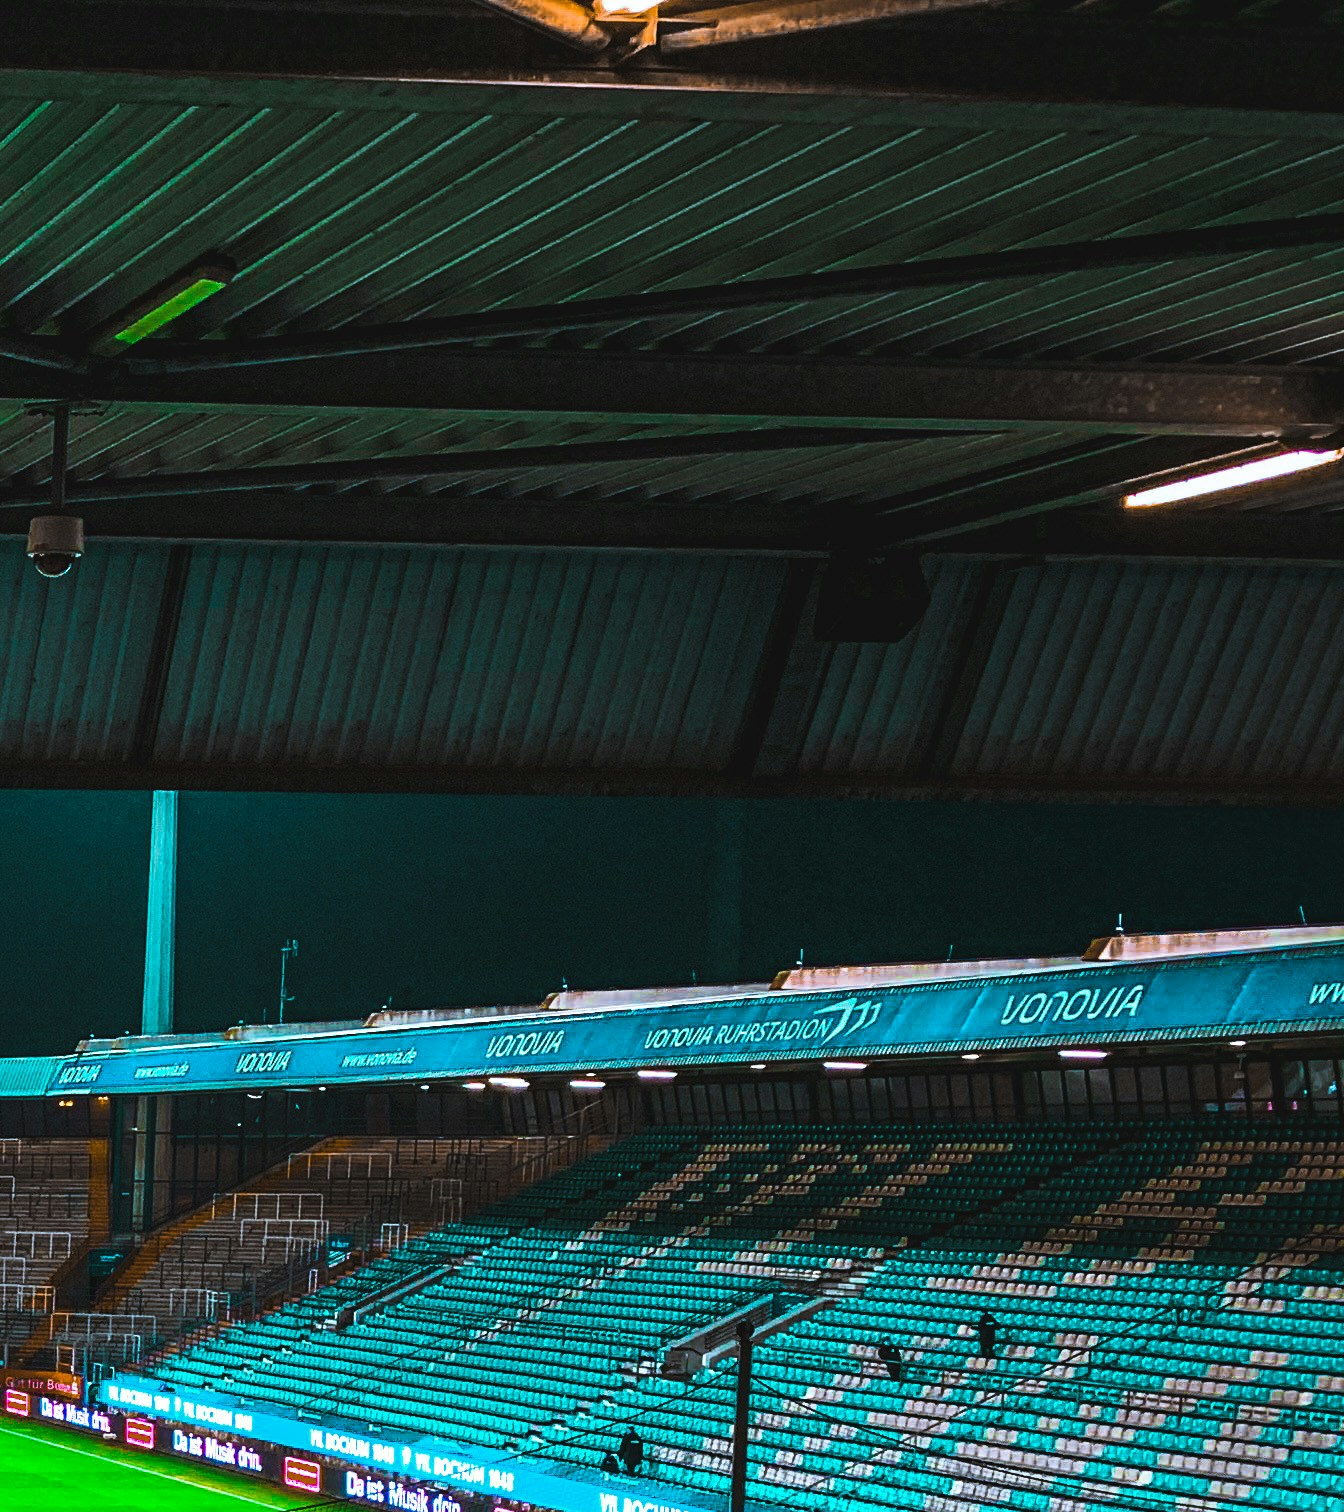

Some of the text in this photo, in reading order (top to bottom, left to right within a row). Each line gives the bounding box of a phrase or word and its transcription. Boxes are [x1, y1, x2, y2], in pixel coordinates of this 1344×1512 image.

[1001, 984, 1144, 1025] VONOVIA
[485, 1030, 564, 1058] VONOVIA
[714, 1017, 833, 1044] RUHRSTADION
[341, 1047, 416, 1068] www.vonovia.de
[174, 1429, 188, 1452] Da
[189, 1433, 202, 1457] ist
[206, 1437, 236, 1464] Musik
[346, 1471, 364, 1497] Da
